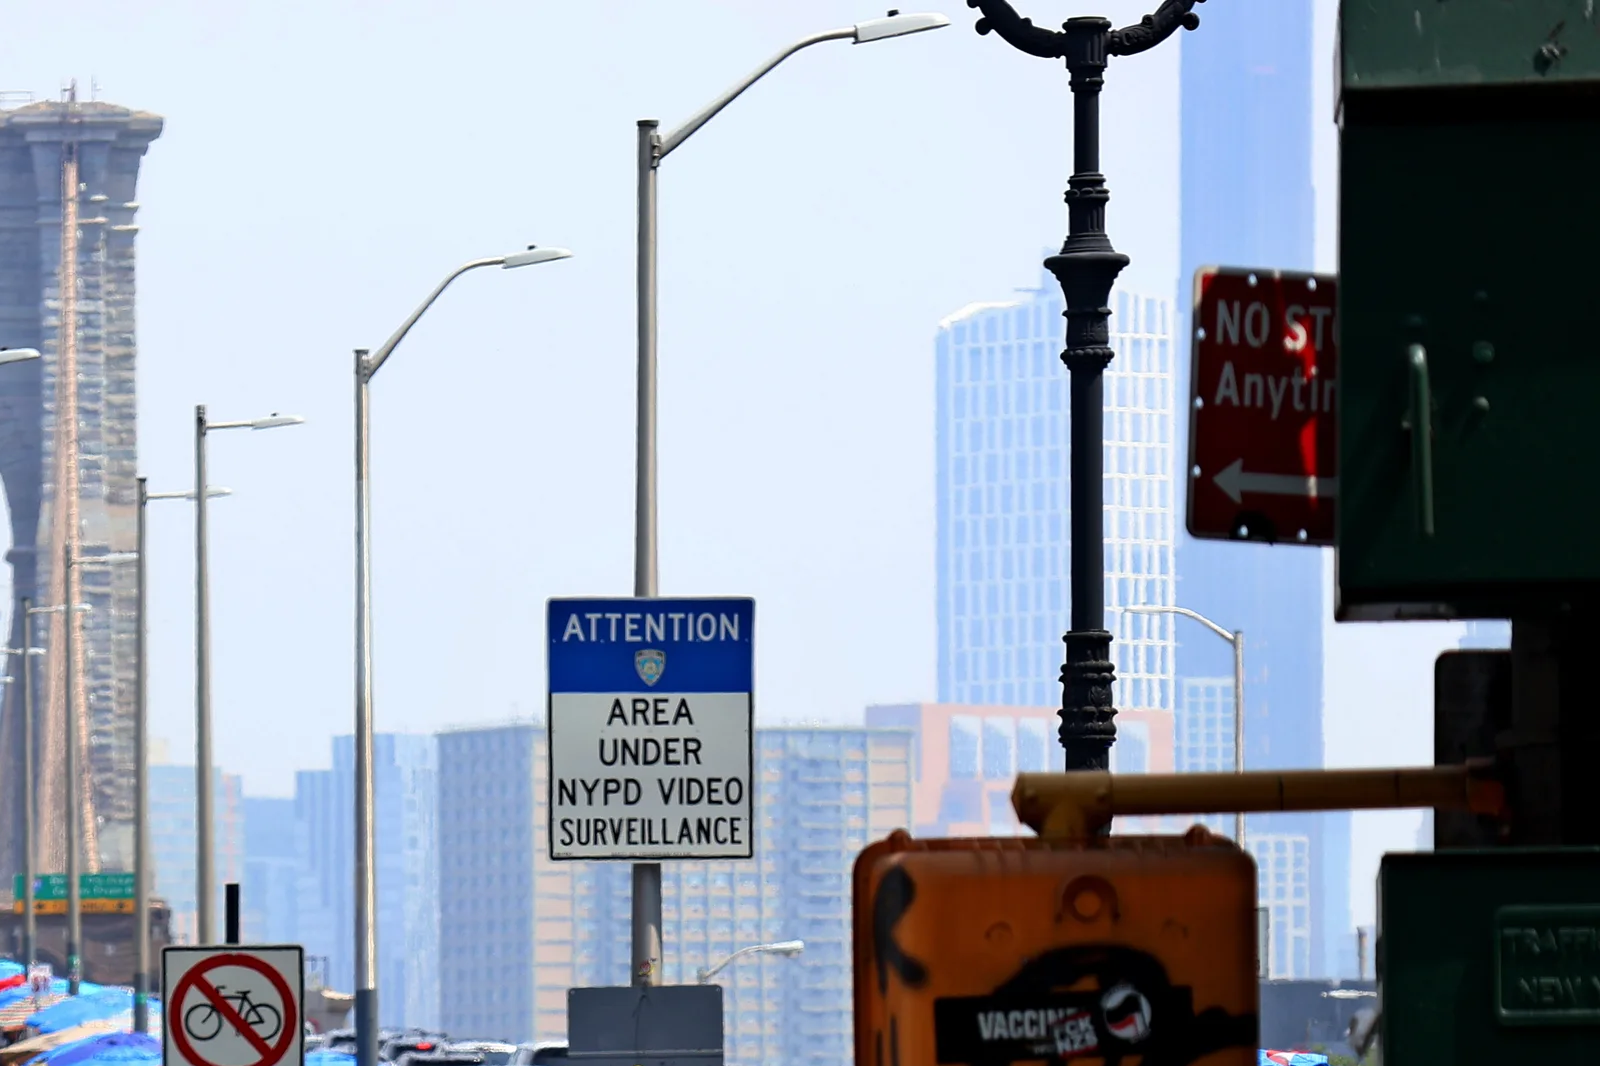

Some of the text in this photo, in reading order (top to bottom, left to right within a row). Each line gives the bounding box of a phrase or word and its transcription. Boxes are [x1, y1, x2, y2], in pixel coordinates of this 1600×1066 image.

[1215, 298, 1270, 347] NO
[562, 612, 739, 642] ATTENTION
[607, 698, 694, 725] AREA
[599, 738, 703, 766] UNDER
[558, 777, 743, 806] NYPD VIDEO
[560, 817, 742, 846] SURVEILLANCE
[1502, 926, 1600, 954] TRAFFI
